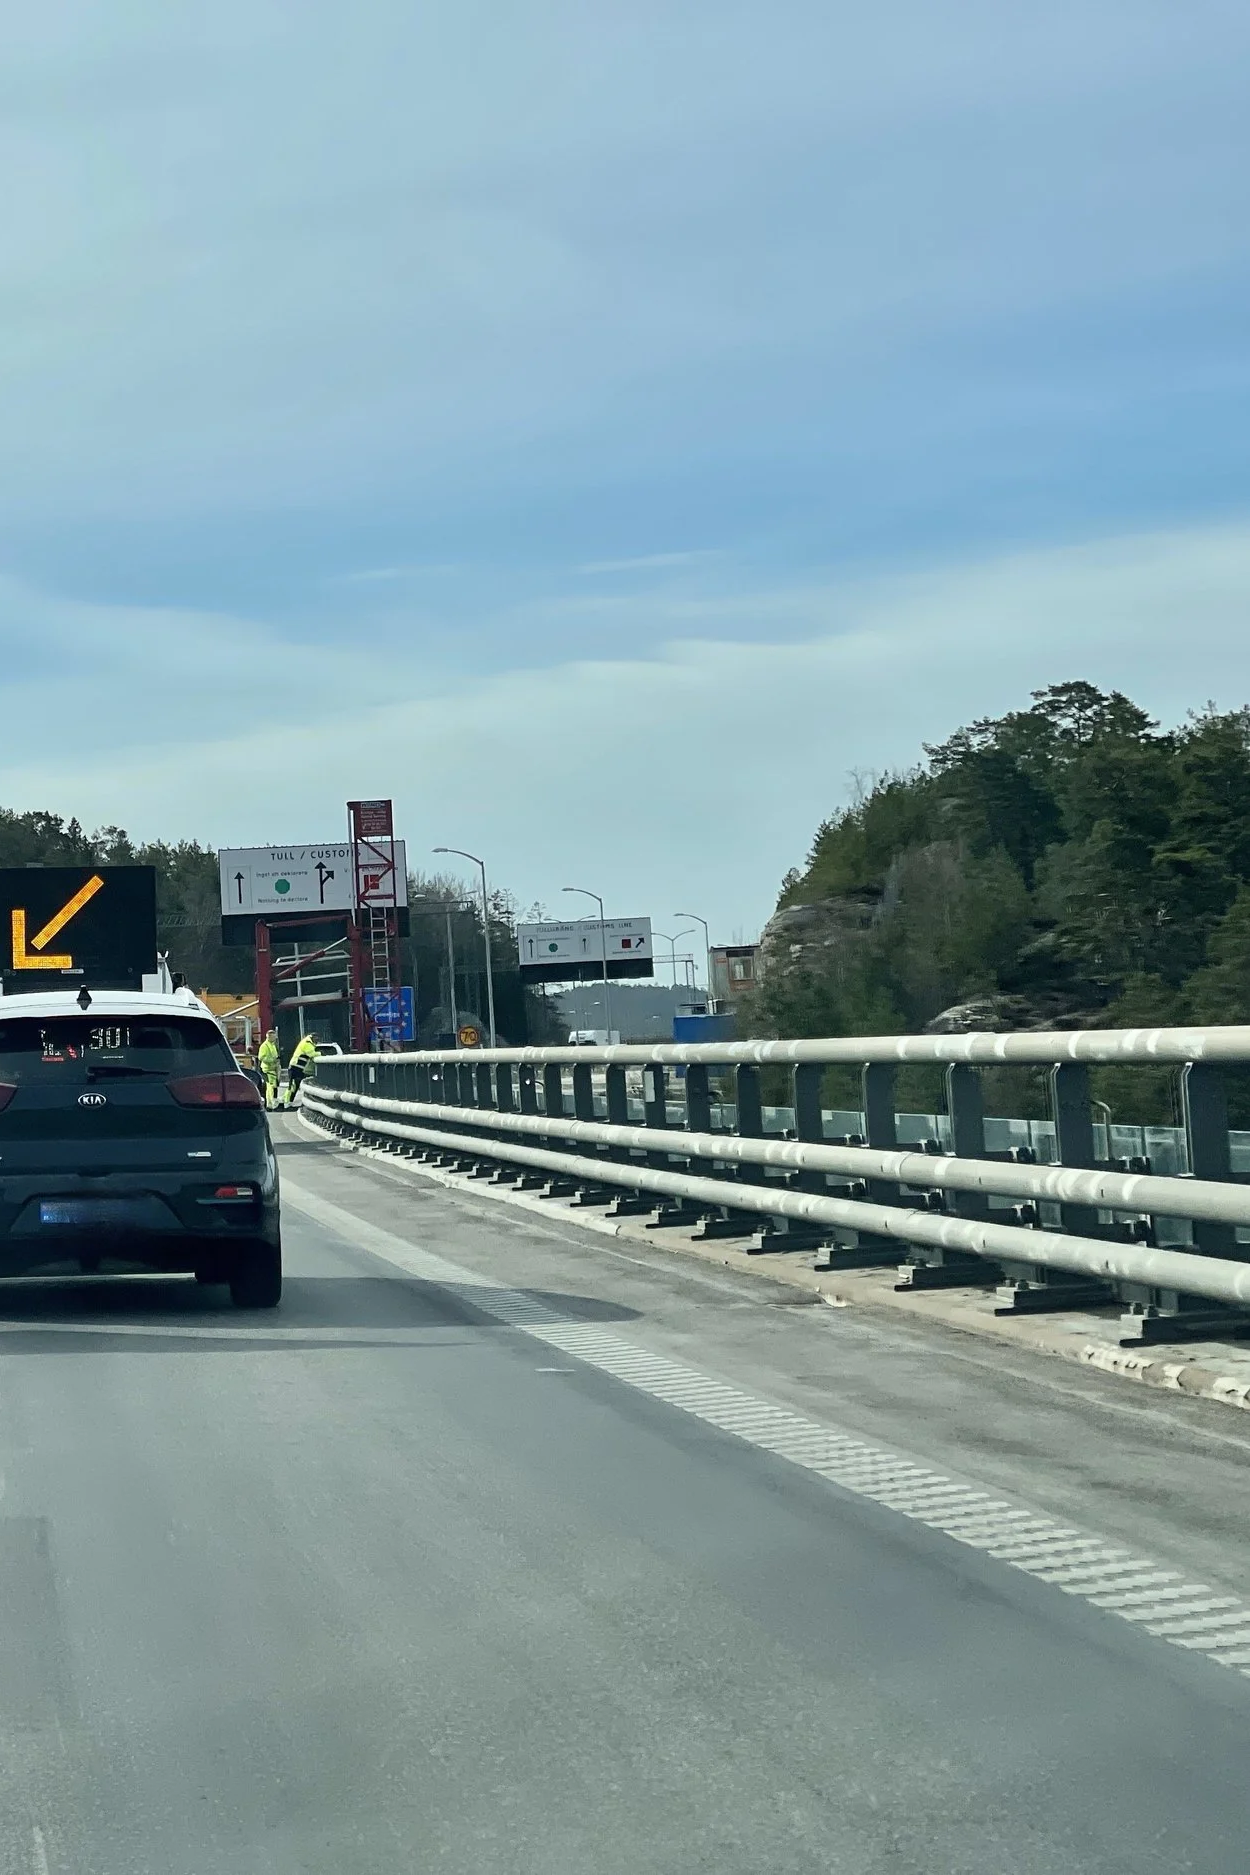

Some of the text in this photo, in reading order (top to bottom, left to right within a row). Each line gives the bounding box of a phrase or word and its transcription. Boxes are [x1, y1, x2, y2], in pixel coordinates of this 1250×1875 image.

[271, 852, 294, 861] TULL
[461, 1031, 477, 1042] 70
[82, 1096, 102, 1105] KIA
